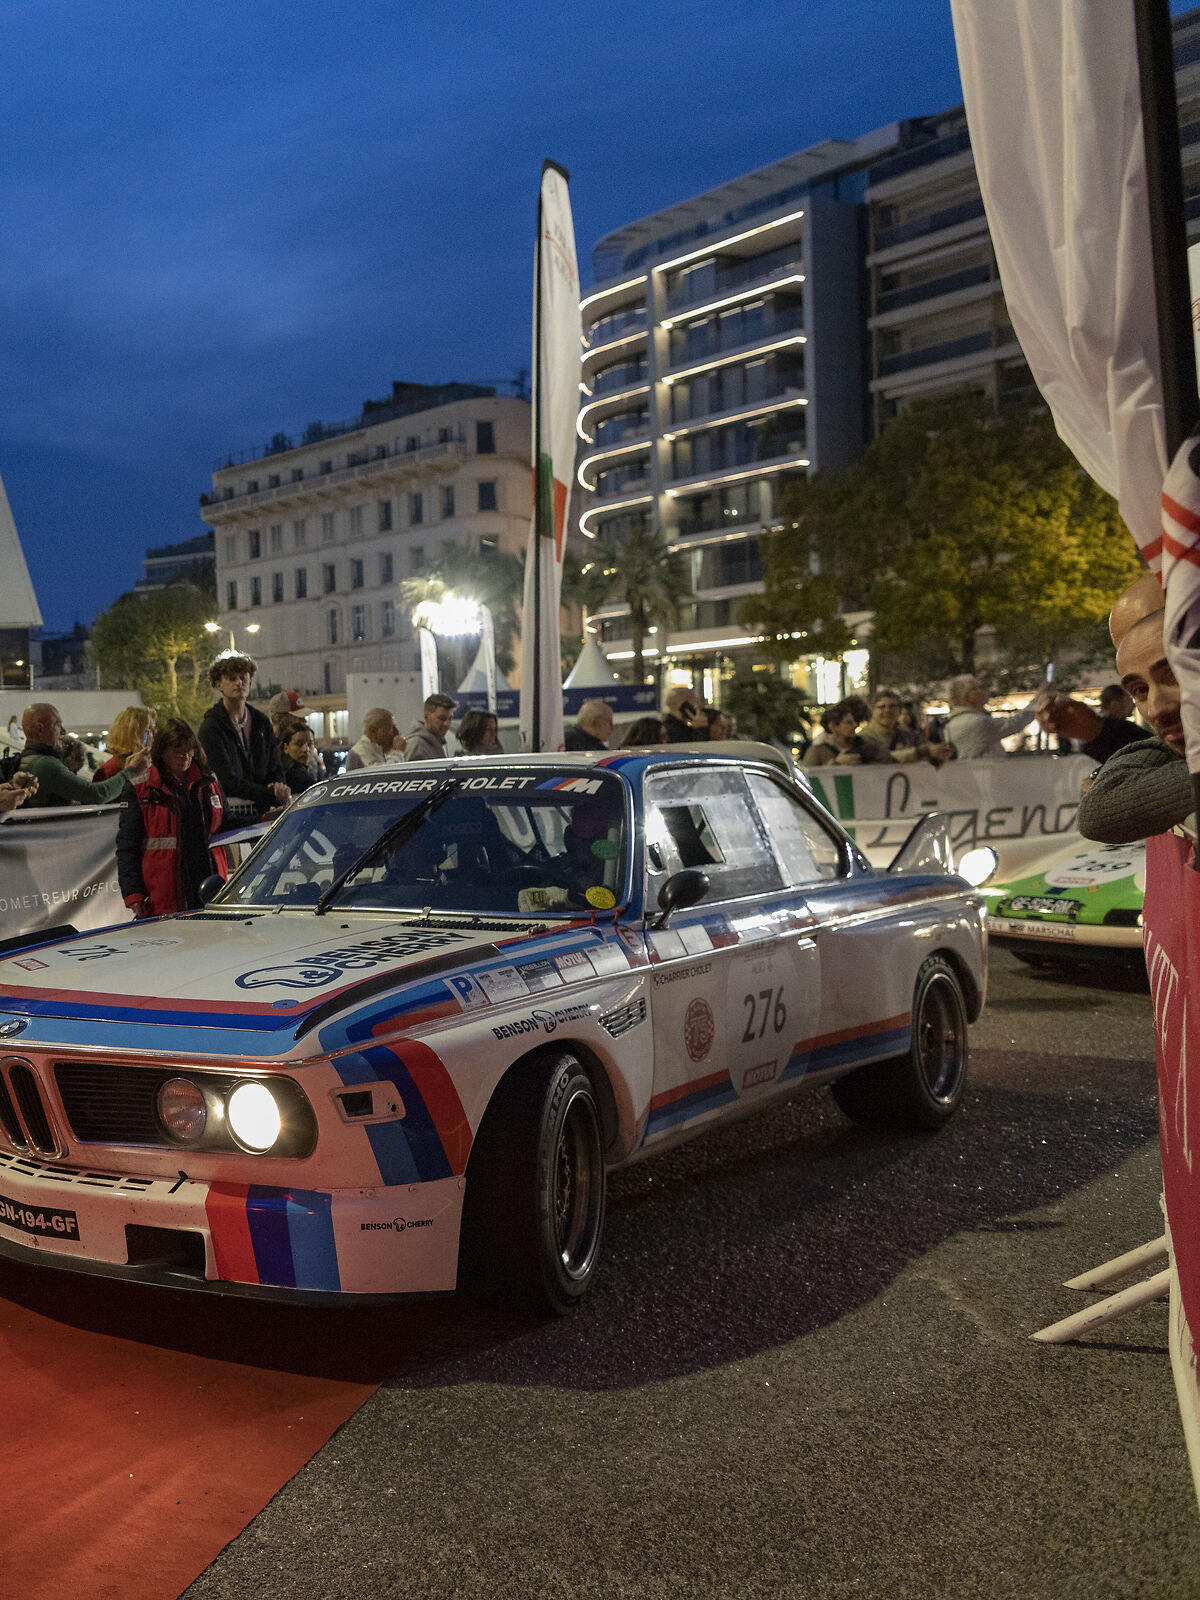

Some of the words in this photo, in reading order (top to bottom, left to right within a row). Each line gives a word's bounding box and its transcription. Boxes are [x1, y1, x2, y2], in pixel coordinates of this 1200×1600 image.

[330, 779, 438, 798] CHARRIER
[294, 929, 448, 966] BENSON
[334, 932, 476, 970] CHERRY
[555, 951, 587, 969] MOTUL
[449, 976, 473, 1004] P
[741, 984, 787, 1044] 276
[491, 1017, 540, 1041] BENSON
[360, 1222, 393, 1231] BENSON
[406, 1219, 435, 1228] CHERRY
